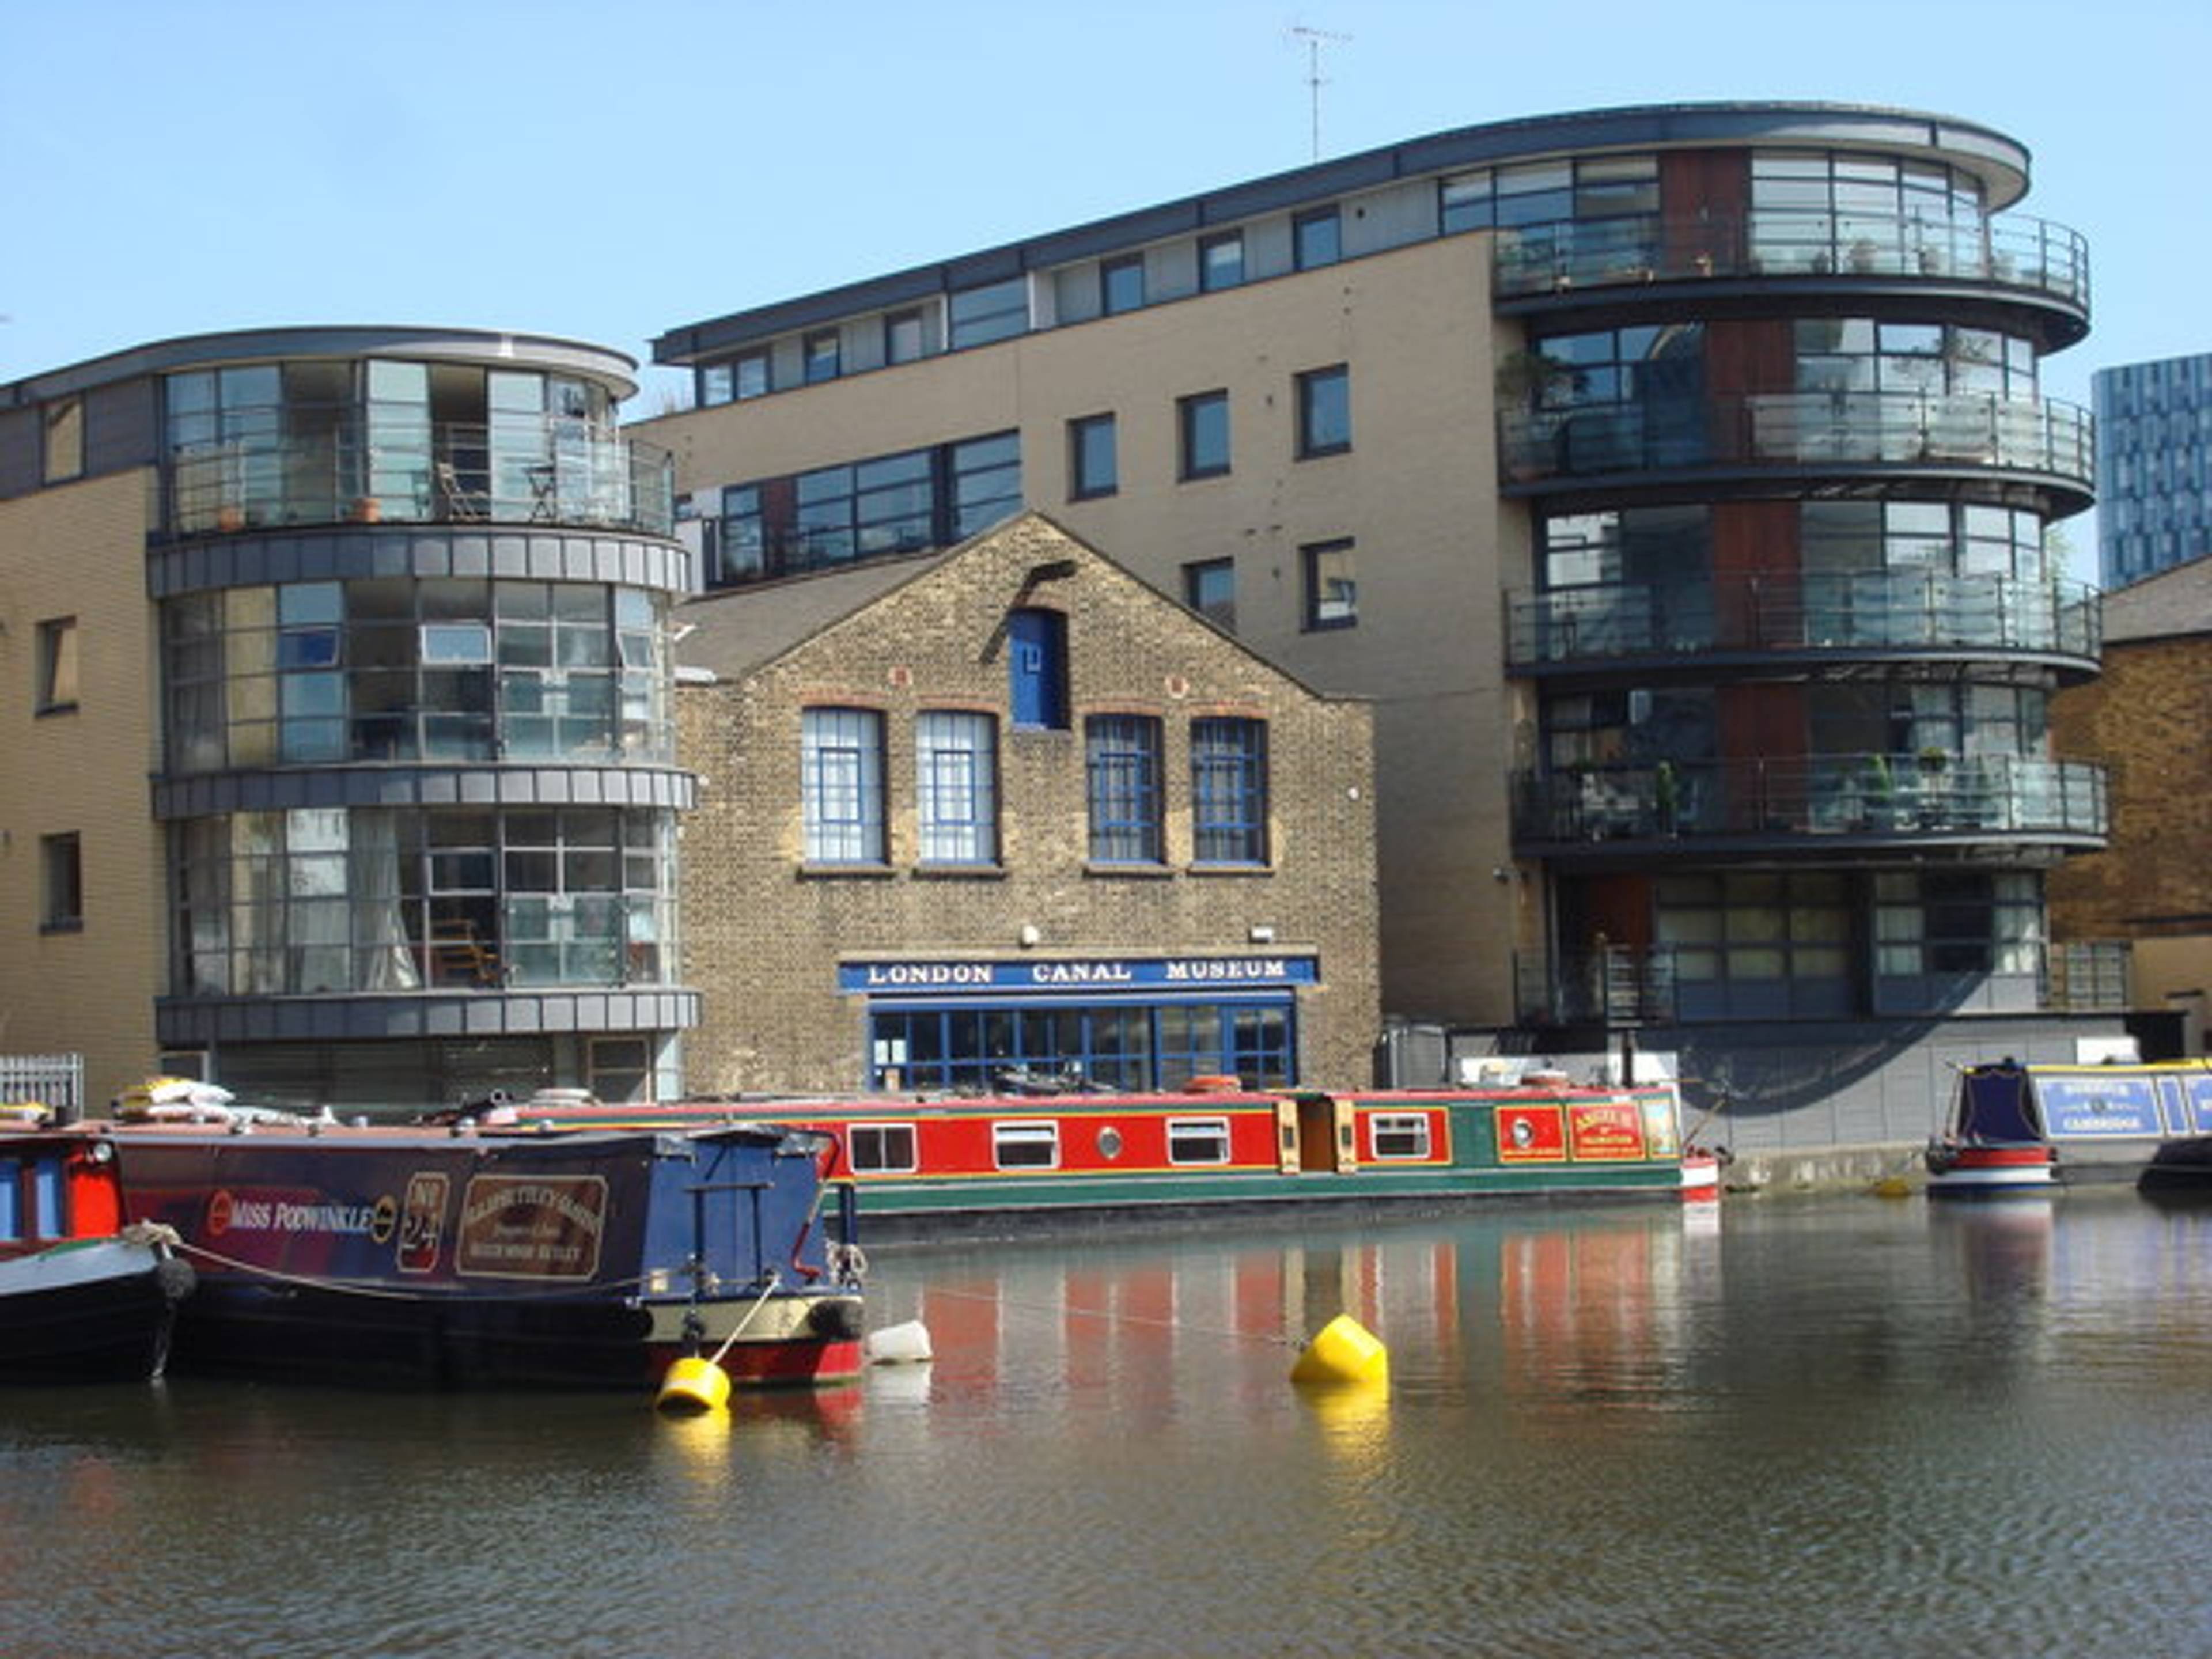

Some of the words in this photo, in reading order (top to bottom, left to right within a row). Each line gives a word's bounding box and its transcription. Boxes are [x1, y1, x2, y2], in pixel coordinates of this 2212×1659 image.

[868, 964, 993, 984] LONDON
[1033, 963, 1131, 983] CANAL
[1165, 960, 1286, 979] MUSEUM
[232, 1198, 271, 1229] MISS
